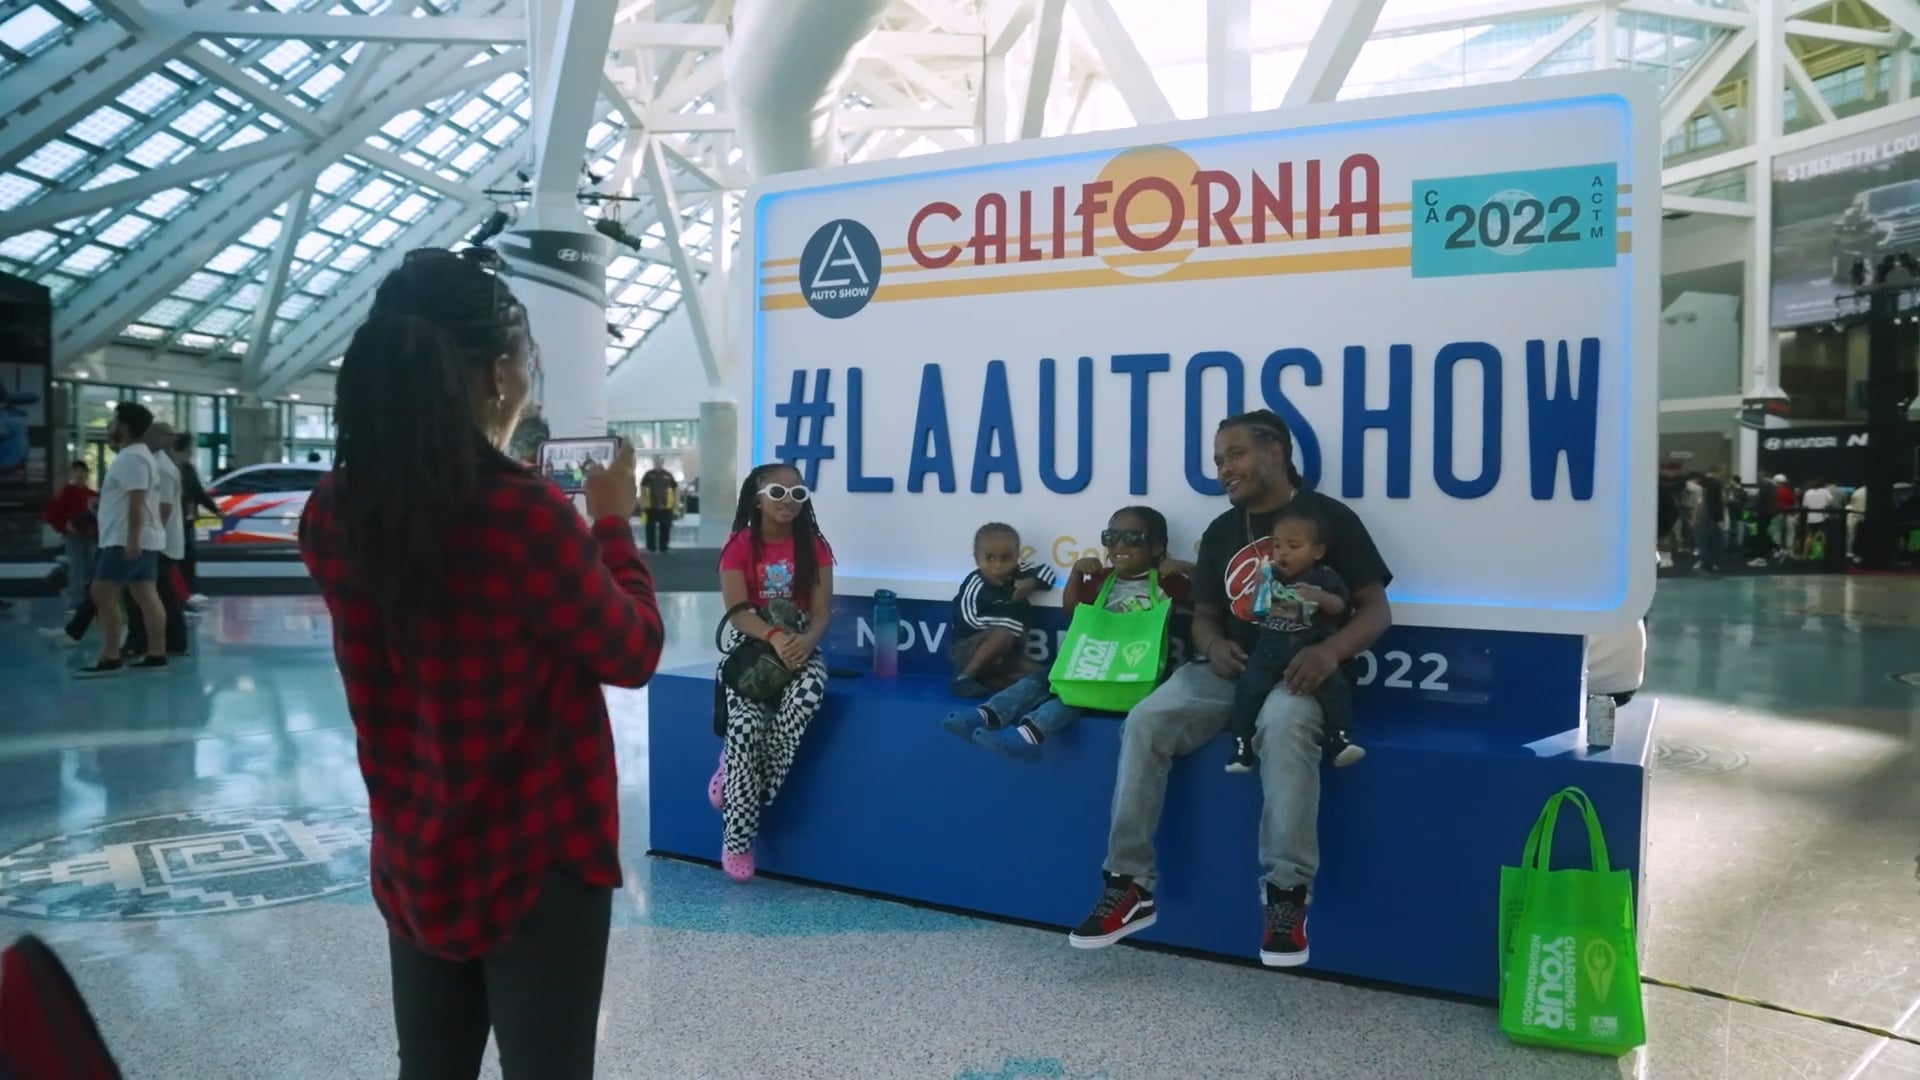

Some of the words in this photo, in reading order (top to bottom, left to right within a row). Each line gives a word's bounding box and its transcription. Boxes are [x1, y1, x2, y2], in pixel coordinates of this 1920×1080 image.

[1881, 130, 1920, 158] LOO
[907, 153, 1381, 269] CALIFORNIA
[1444, 195, 1581, 250] 2022
[810, 289, 837, 300] AUTO
[839, 287, 869, 299] SHOW
[775, 337, 1601, 501] #LAAUTOSHOW
[1354, 649, 1449, 691] 022
[1521, 934, 1542, 1026] NEIGHBORHOOD
[1534, 936, 1564, 1030] YOUR
[1564, 936, 1576, 1008] CHARGING
[1564, 1012, 1576, 1031] UP
